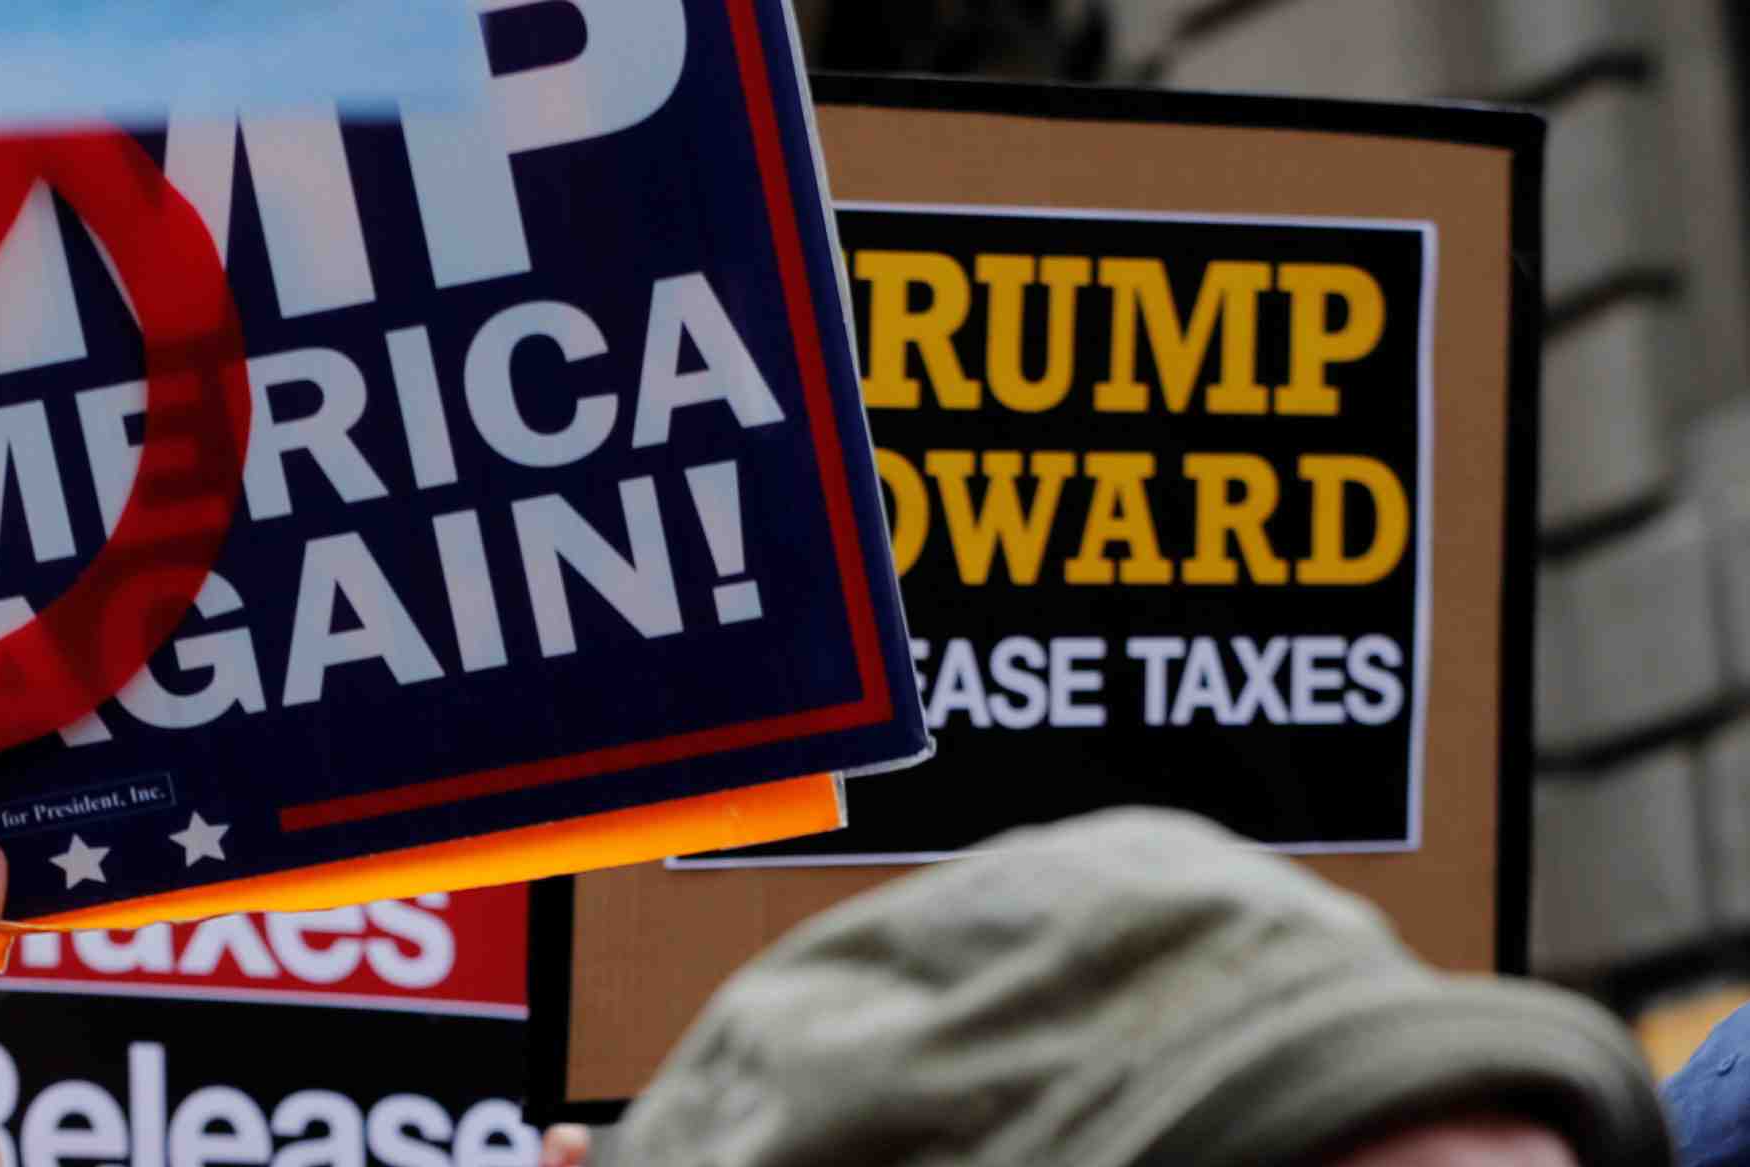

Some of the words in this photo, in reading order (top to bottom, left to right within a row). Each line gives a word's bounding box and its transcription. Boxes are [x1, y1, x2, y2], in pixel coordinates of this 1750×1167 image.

[842, 249, 1386, 416] RUMP
[1125, 634, 1404, 726] TAXES
[1, 809, 30, 829] for
[129, 784, 166, 804] Inc.
